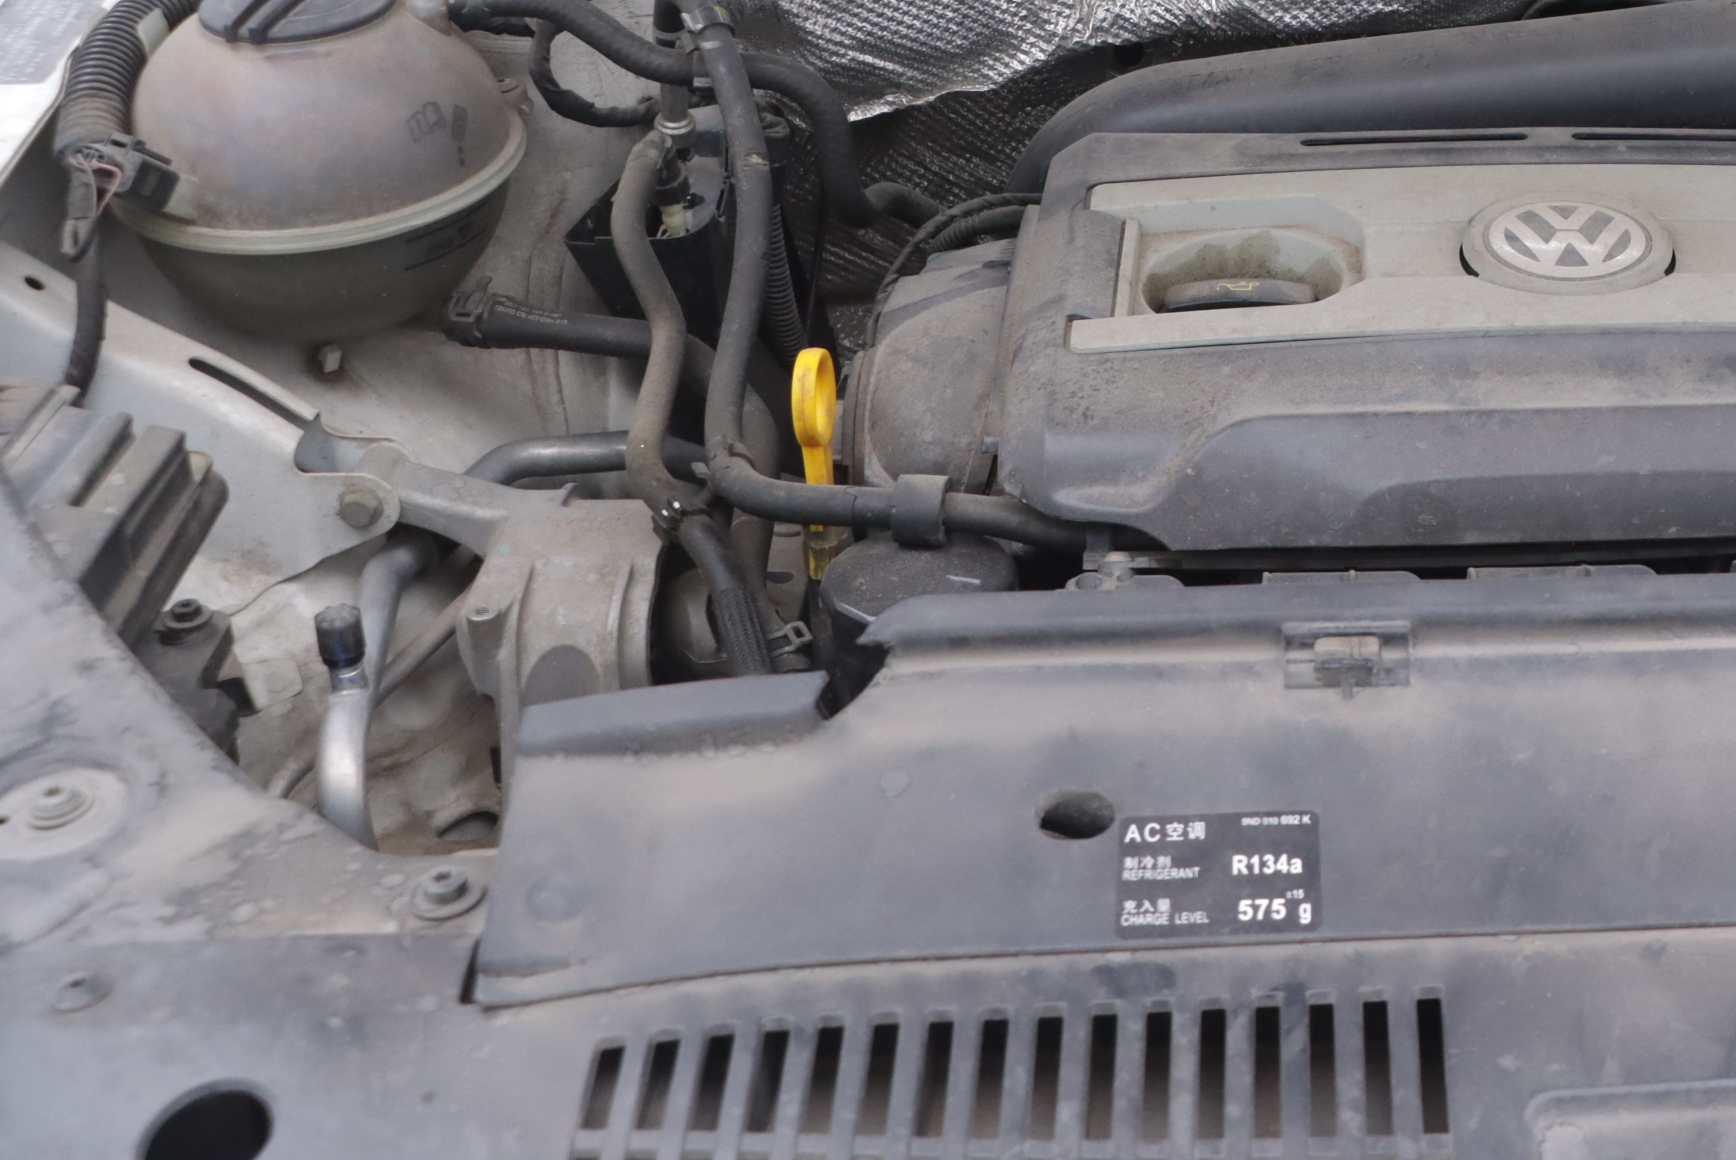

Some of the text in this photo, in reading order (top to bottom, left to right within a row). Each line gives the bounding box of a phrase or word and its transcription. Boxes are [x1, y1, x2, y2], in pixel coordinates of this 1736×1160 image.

[1301, 814, 1312, 824] K
[1232, 854, 1303, 875] R134a
[1121, 867, 1201, 881] REFRIGERANT
[1120, 910, 1210, 926] CHARGE LEVEL
[1238, 898, 1312, 925] 575 g
